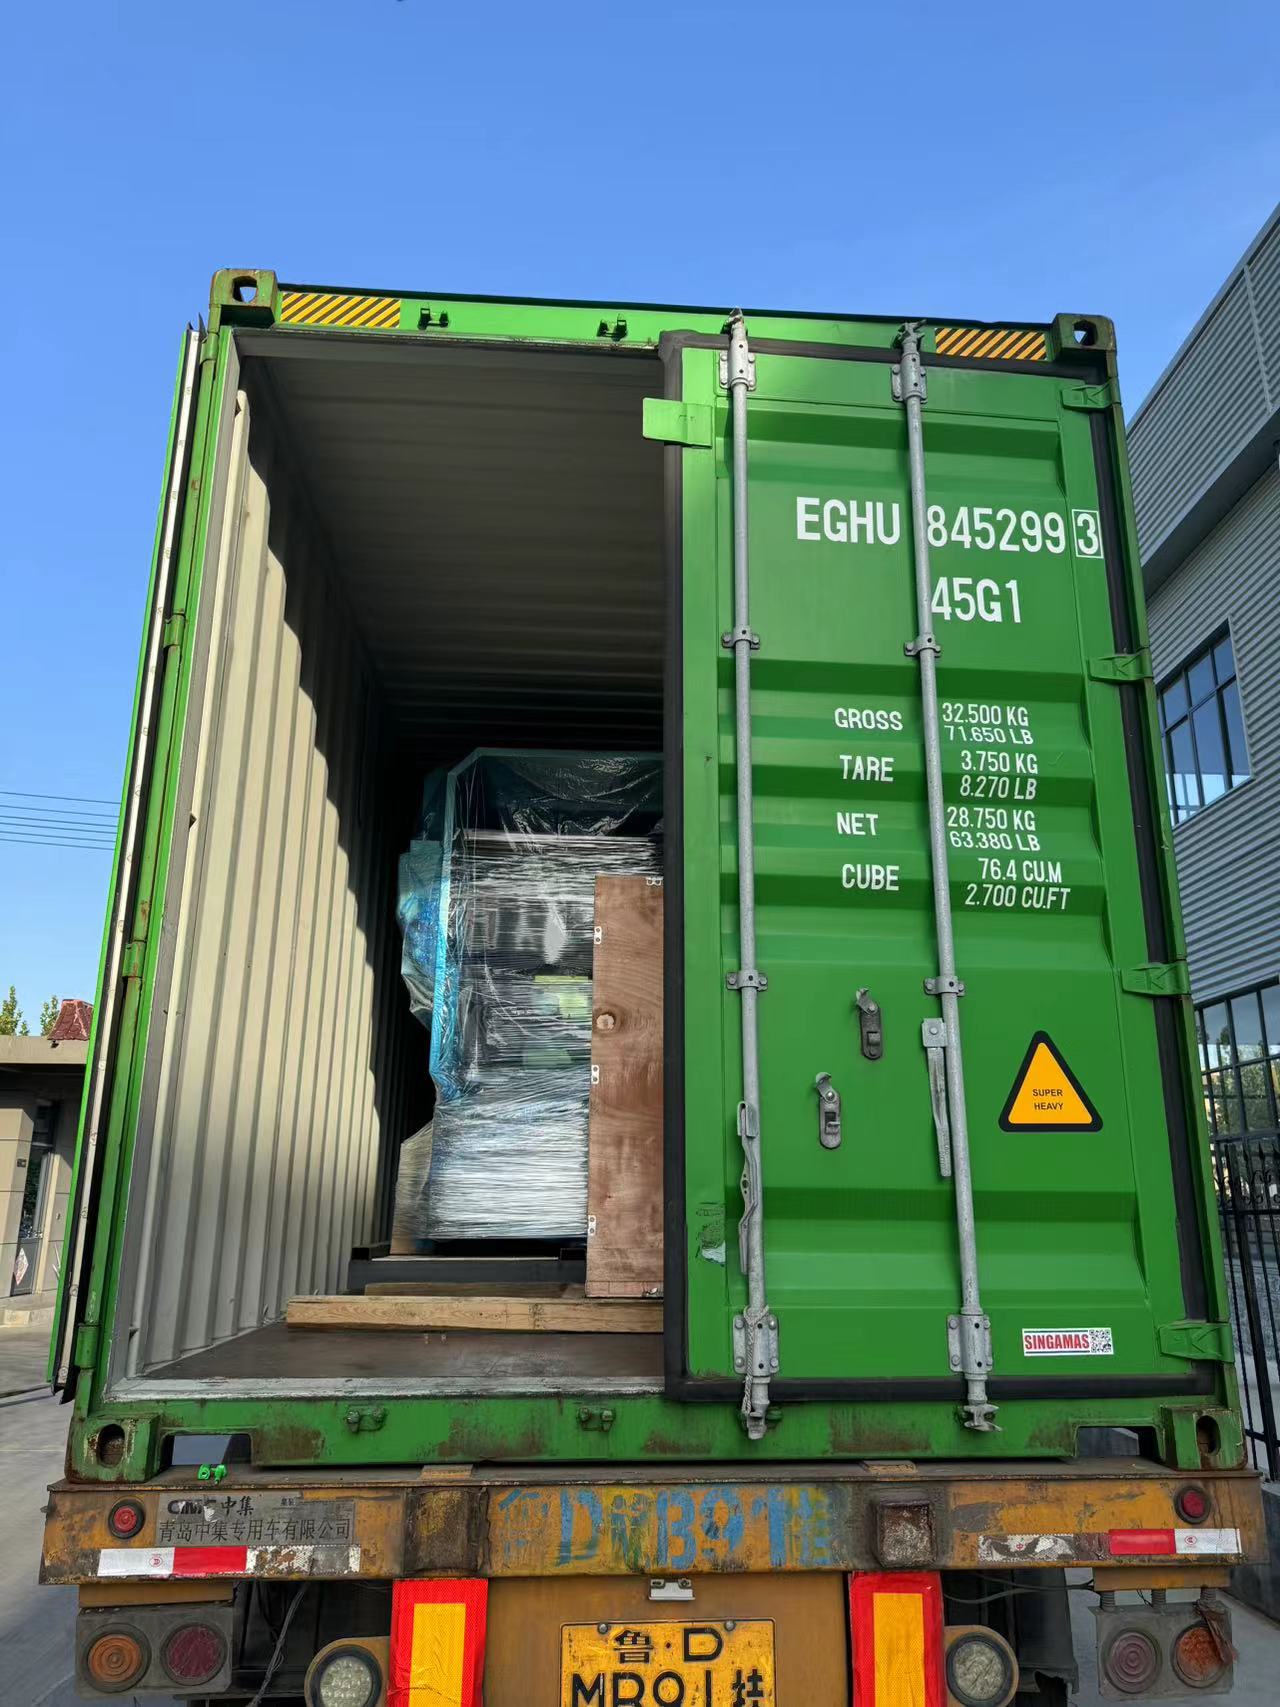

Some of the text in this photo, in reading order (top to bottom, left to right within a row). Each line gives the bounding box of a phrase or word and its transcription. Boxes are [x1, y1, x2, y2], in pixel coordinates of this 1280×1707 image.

[796, 496, 900, 545] EGHU
[932, 577, 1021, 623] 45G1
[835, 703, 1028, 730] GROSS 32.500 KG
[947, 727, 1033, 744] 71.650 LB
[840, 750, 1038, 781] TARE 3.750 KG
[960, 775, 1036, 799] 8.270 LB
[837, 807, 1035, 835] NET 28.750 KG
[950, 831, 1040, 851] 63.380 LB
[842, 858, 1062, 890] CUBE 76.4 CU.M
[965, 884, 1070, 909] 2.700 CU.FT
[1032, 1088, 1064, 1097] SUPER
[1034, 1102, 1064, 1111] HEAVY
[1024, 1333, 1090, 1350] SINGAMAS
[221, 1495, 254, 1516] 中集
[159, 1518, 350, 1542] 青岛中集专用车有限公司
